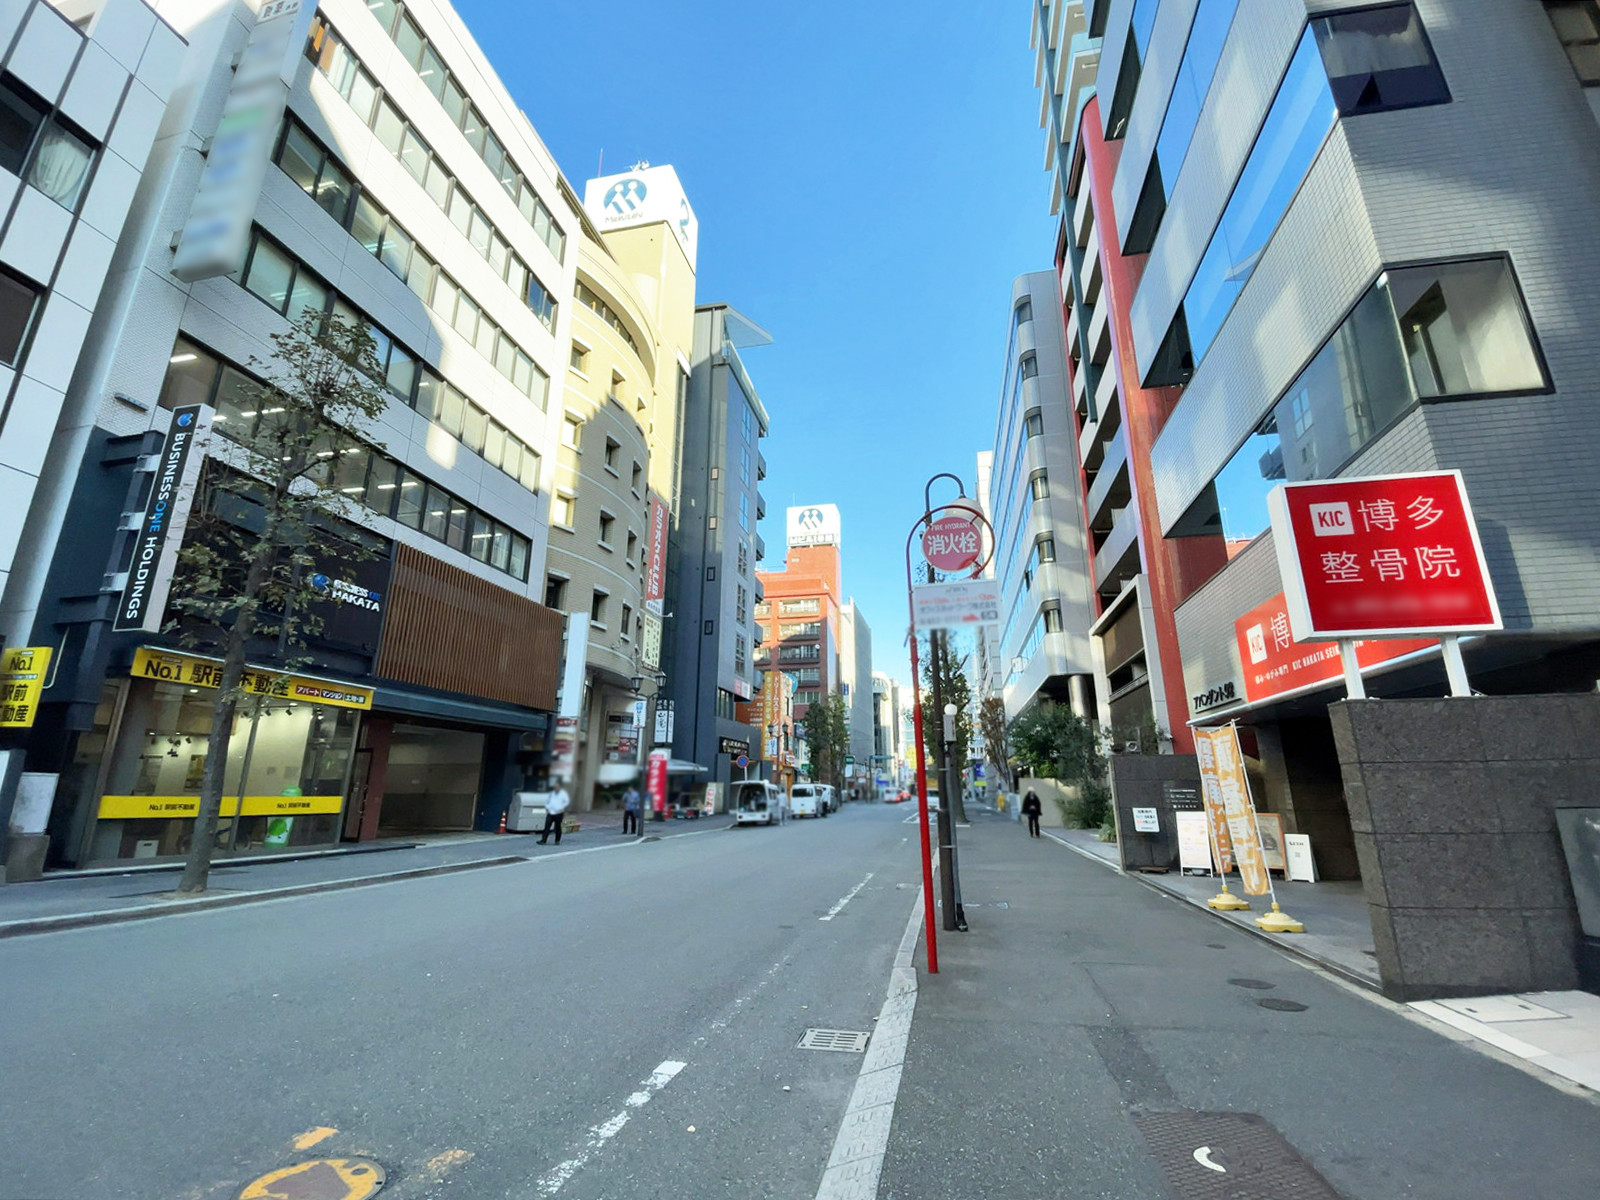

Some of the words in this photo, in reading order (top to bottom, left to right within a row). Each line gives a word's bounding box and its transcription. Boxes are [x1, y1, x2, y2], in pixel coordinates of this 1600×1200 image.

[1318, 510, 1345, 527] KIC
[1357, 496, 1444, 532] 博多
[945, 522, 971, 531] HYDRANT
[927, 532, 978, 556] 消火栓
[1320, 545, 1461, 584] 整骨院
[126, 536, 158, 619] HOLDINGS
[332, 590, 380, 612] HAKATA
[10, 656, 33, 671] No.1
[144, 660, 183, 680] No.1
